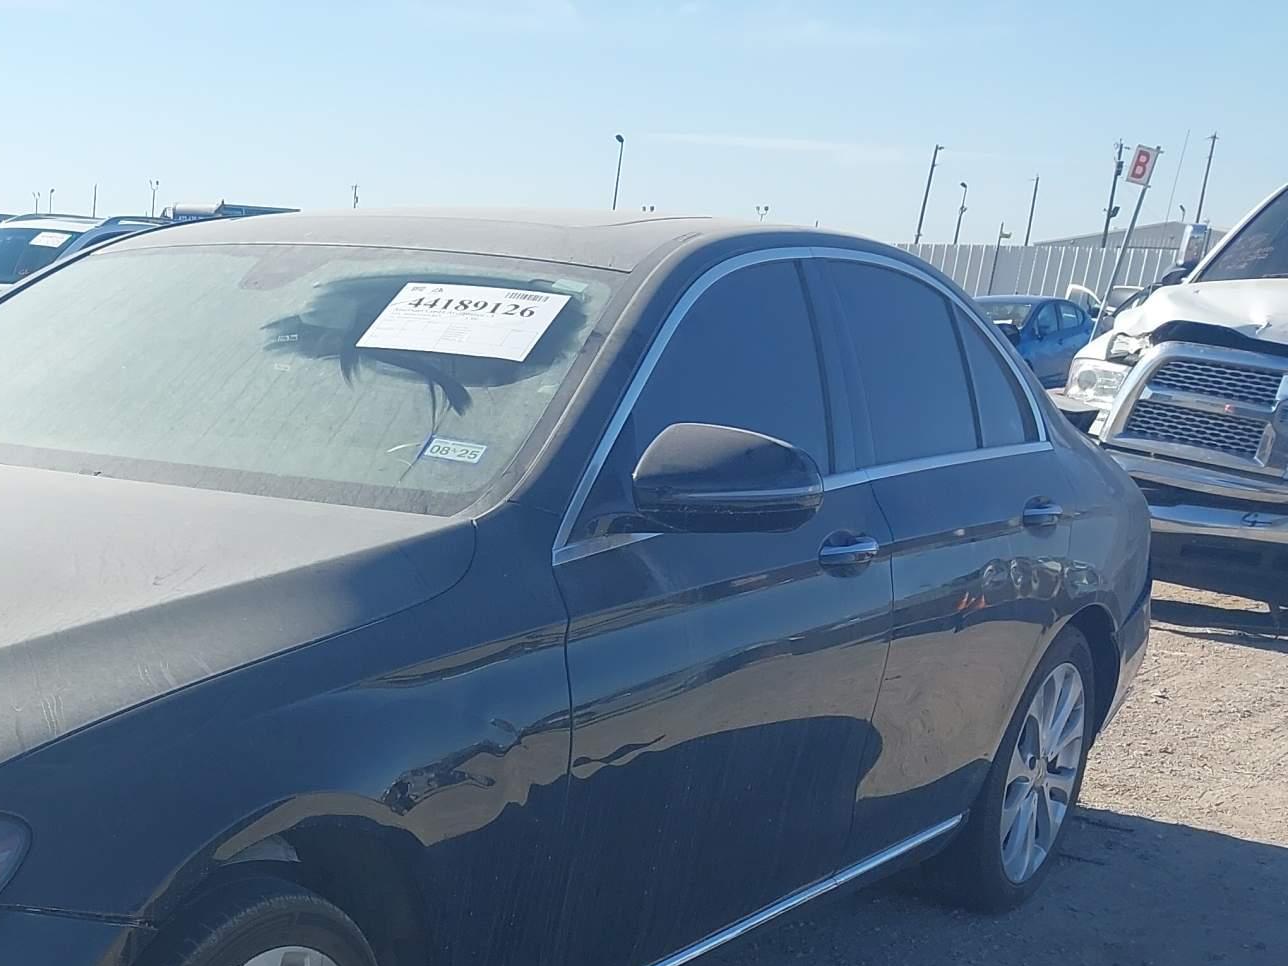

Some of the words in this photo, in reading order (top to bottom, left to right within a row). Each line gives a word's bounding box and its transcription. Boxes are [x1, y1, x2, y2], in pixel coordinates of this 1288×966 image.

[1130, 150, 1151, 179] B
[408, 296, 538, 318] 44189126
[429, 444, 450, 456] 08
[456, 448, 480, 460] 25
